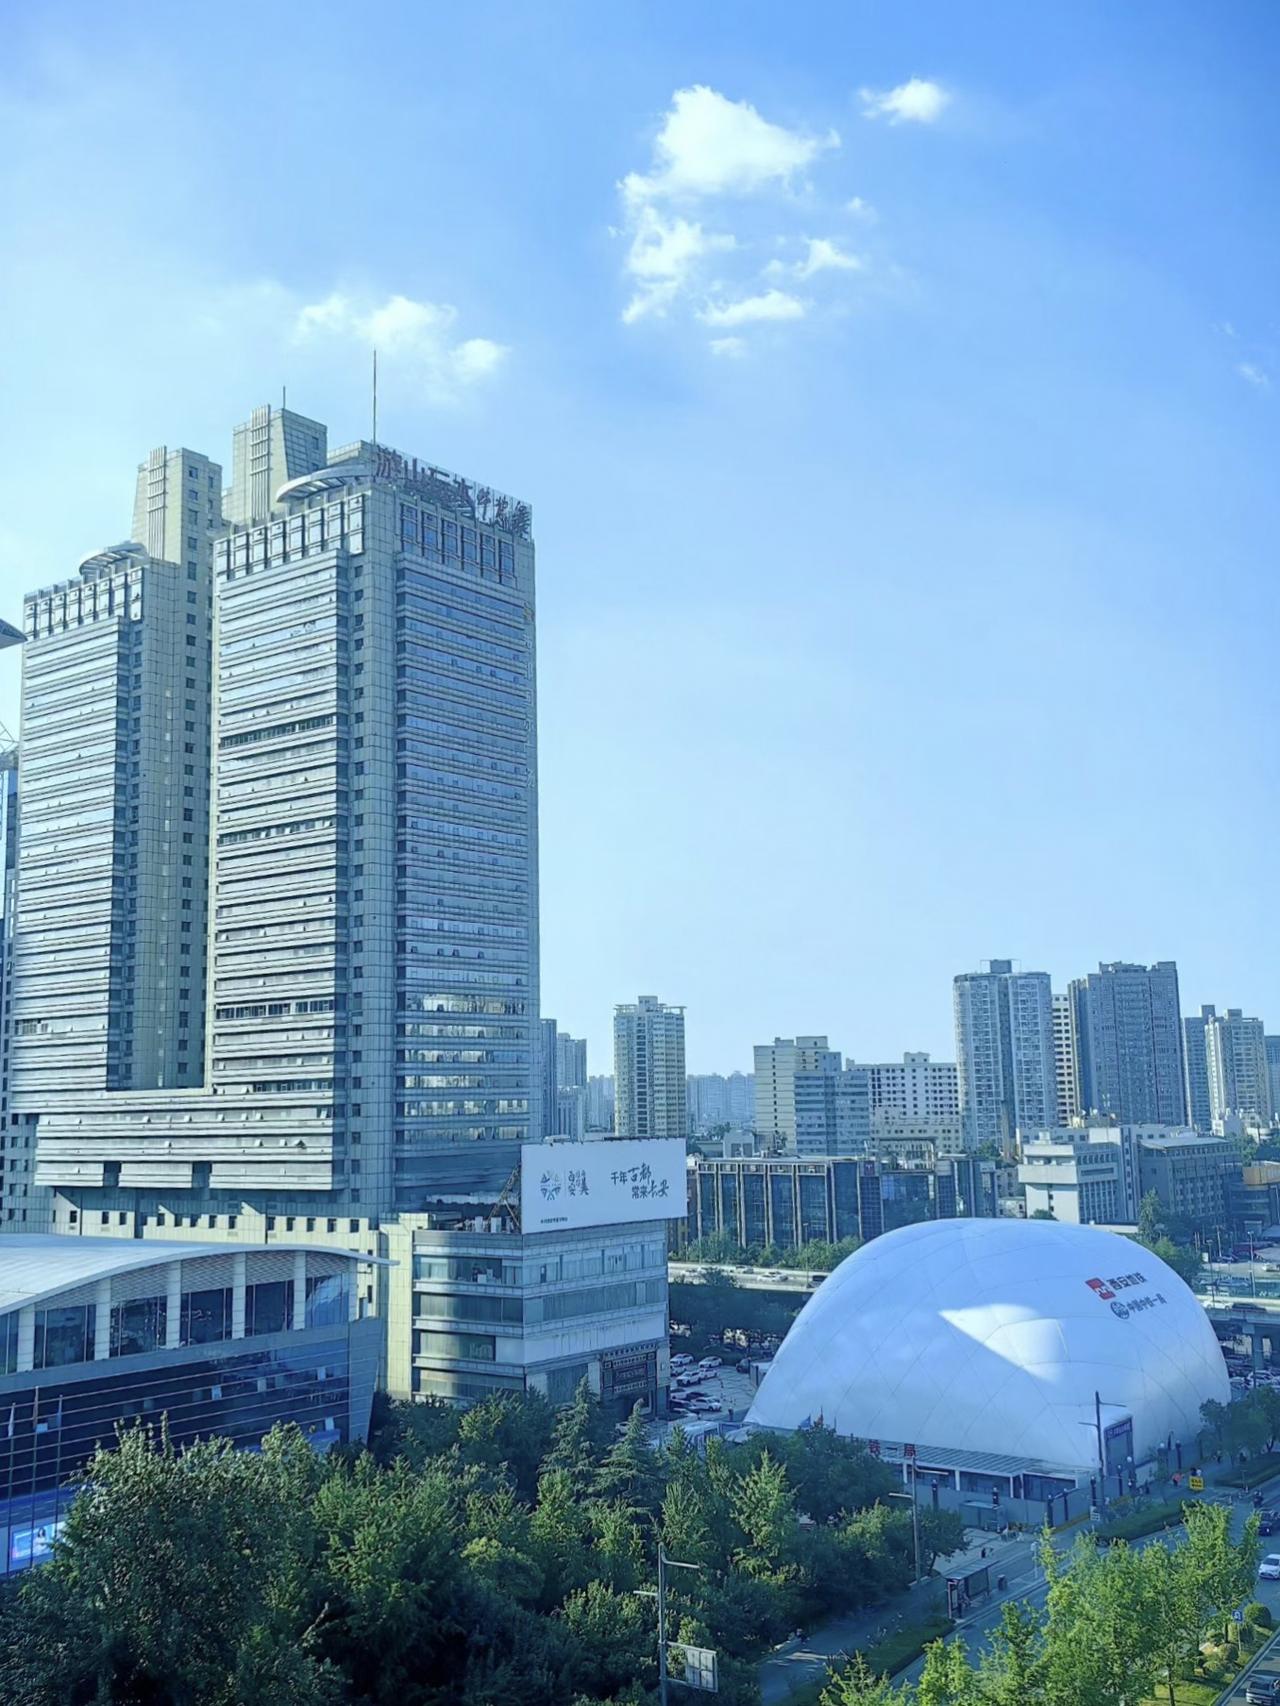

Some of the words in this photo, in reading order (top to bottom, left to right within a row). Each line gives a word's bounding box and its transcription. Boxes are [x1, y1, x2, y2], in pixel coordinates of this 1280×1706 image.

[611, 1162, 652, 1185] 千年古都
[631, 1178, 670, 1199] 常来长安
[1107, 1272, 1146, 1291] 西安地铁
